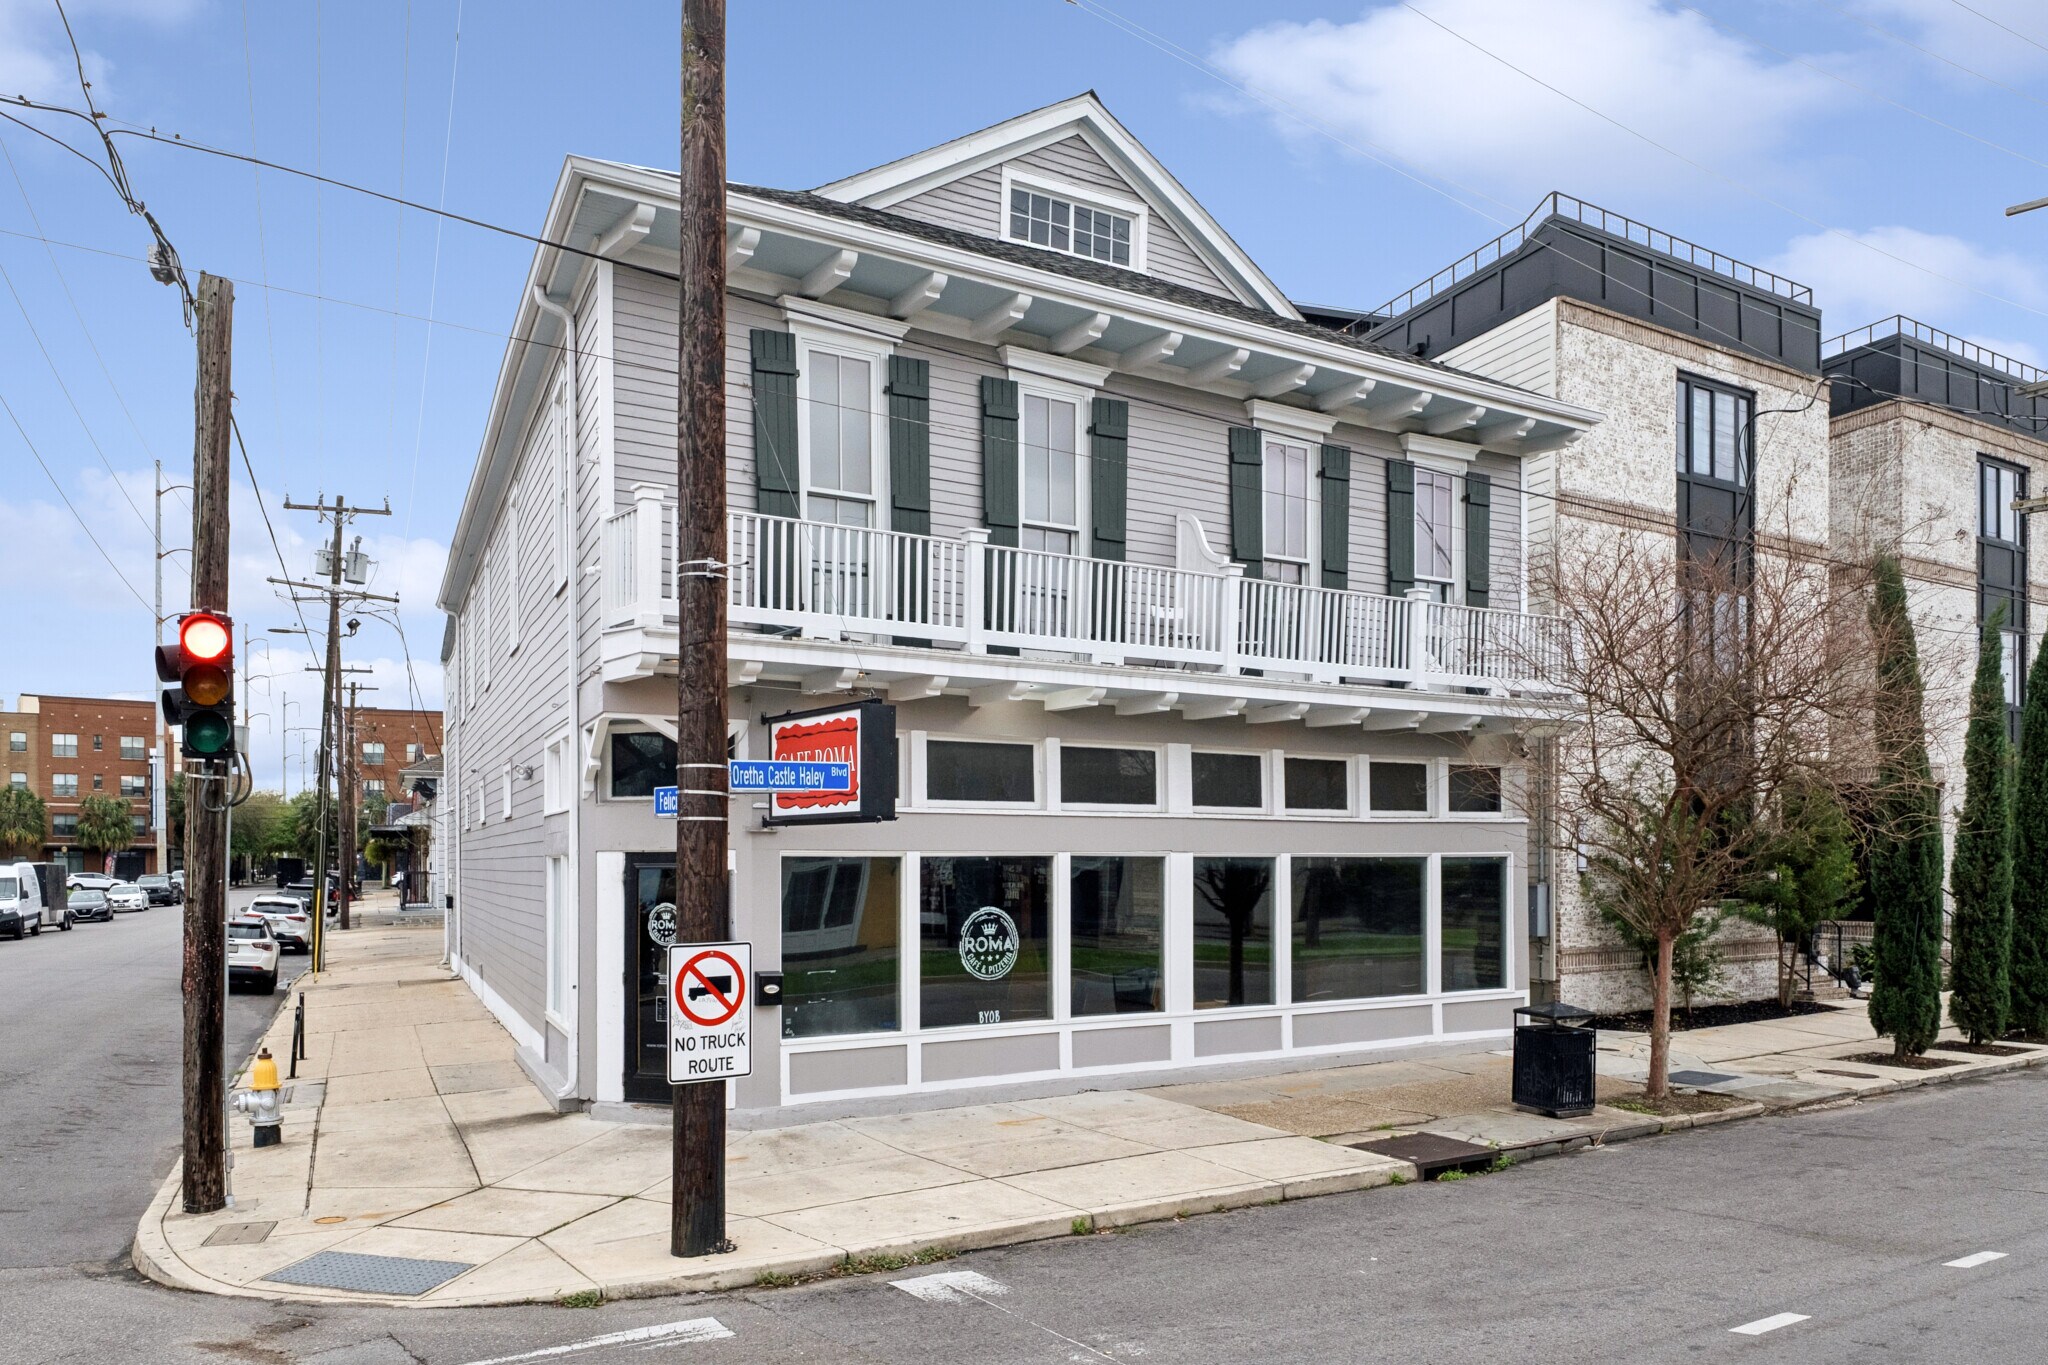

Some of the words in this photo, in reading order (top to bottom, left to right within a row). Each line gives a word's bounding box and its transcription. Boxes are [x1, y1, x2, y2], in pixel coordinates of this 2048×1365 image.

[732, 764, 764, 785] Oretha
[768, 765, 796, 786] Castle
[799, 766, 825, 789] Haley
[831, 766, 848, 777] Blvd
[659, 790, 678, 811] Felici
[651, 919, 677, 930] ROM
[964, 935, 1014, 953] ROMA
[980, 964, 987, 974] &
[988, 951, 1013, 974] PIZZERIA
[978, 1009, 1001, 1024] BYOB
[675, 1036, 696, 1052] NO
[700, 1032, 746, 1050] TRUCK
[688, 1056, 734, 1075] ROUTE
